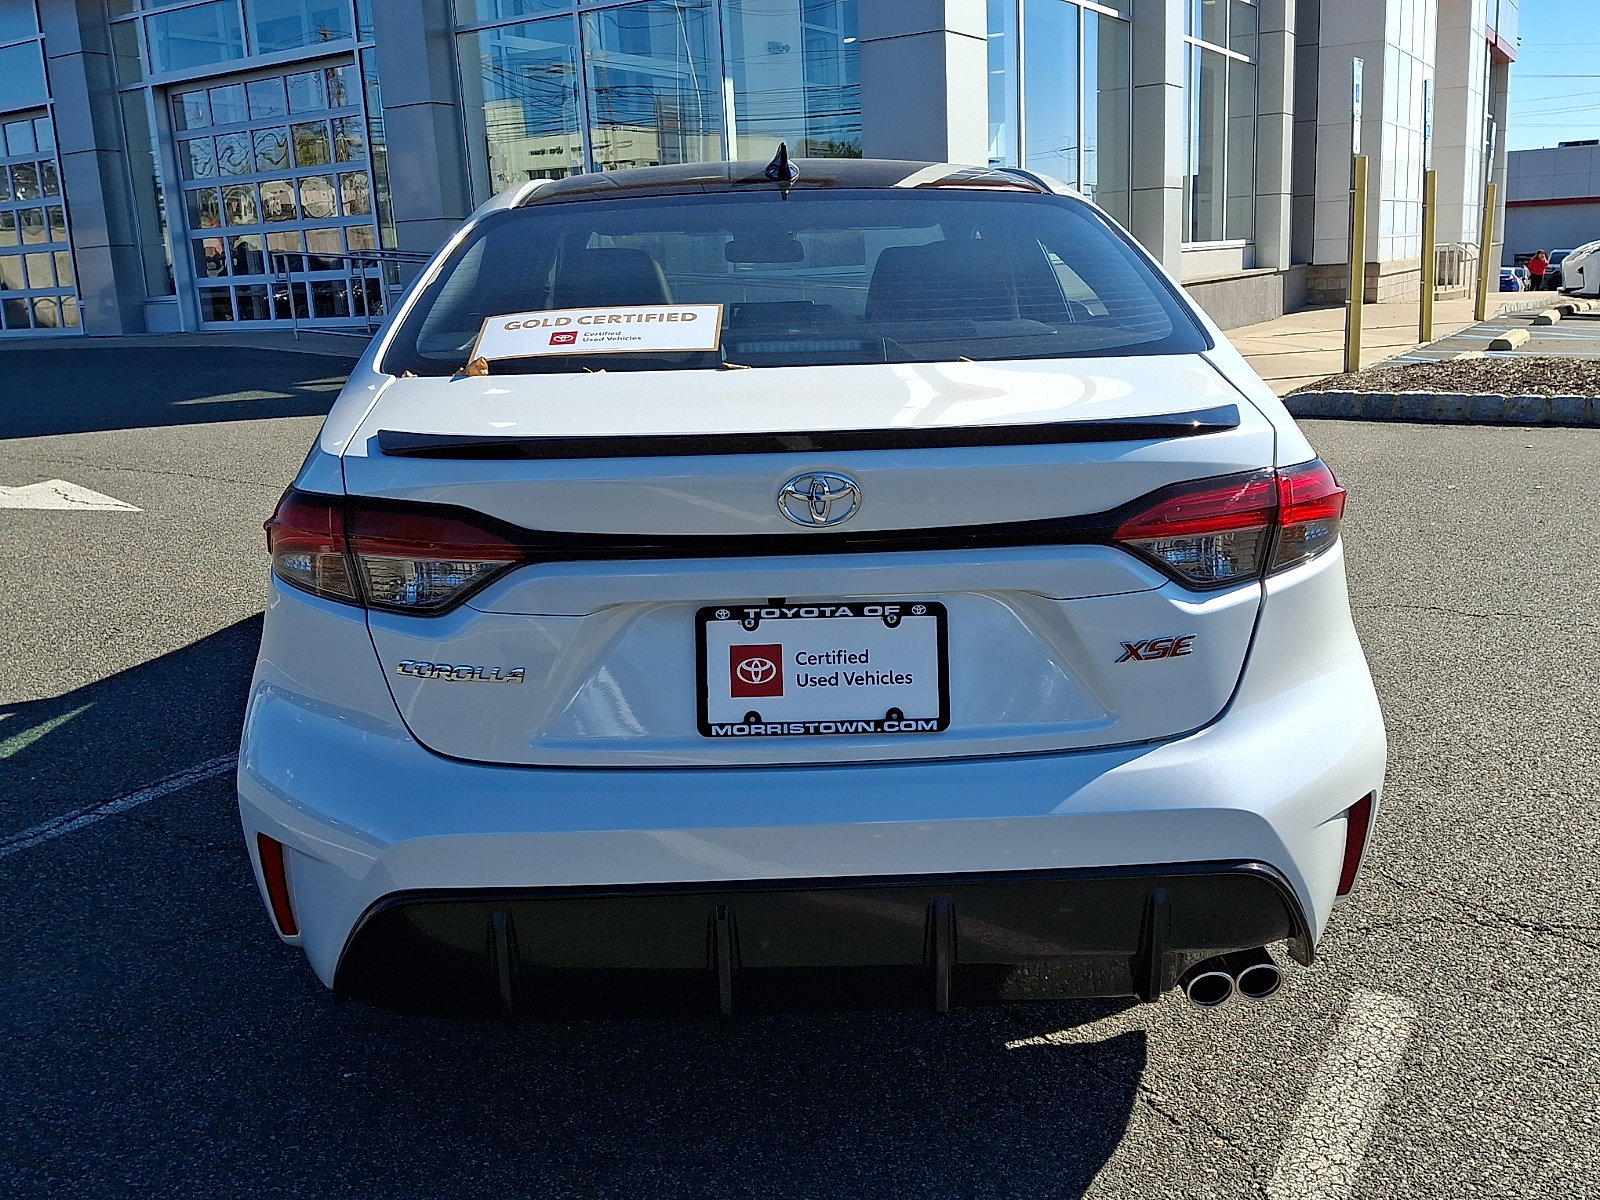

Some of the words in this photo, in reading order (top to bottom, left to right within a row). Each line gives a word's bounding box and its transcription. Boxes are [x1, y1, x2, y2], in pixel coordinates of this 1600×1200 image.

[503, 316, 572, 331] GOLD
[577, 312, 698, 326] CERTIFIED
[743, 606, 854, 619] TOYOTA
[863, 605, 901, 617] OF
[795, 649, 869, 666] Certified
[1115, 633, 1197, 663] XSE
[396, 659, 526, 684] COROLLA
[796, 671, 839, 688] Used
[843, 669, 913, 687] Vehicles
[711, 719, 938, 736] MORRISTOWN.COM
